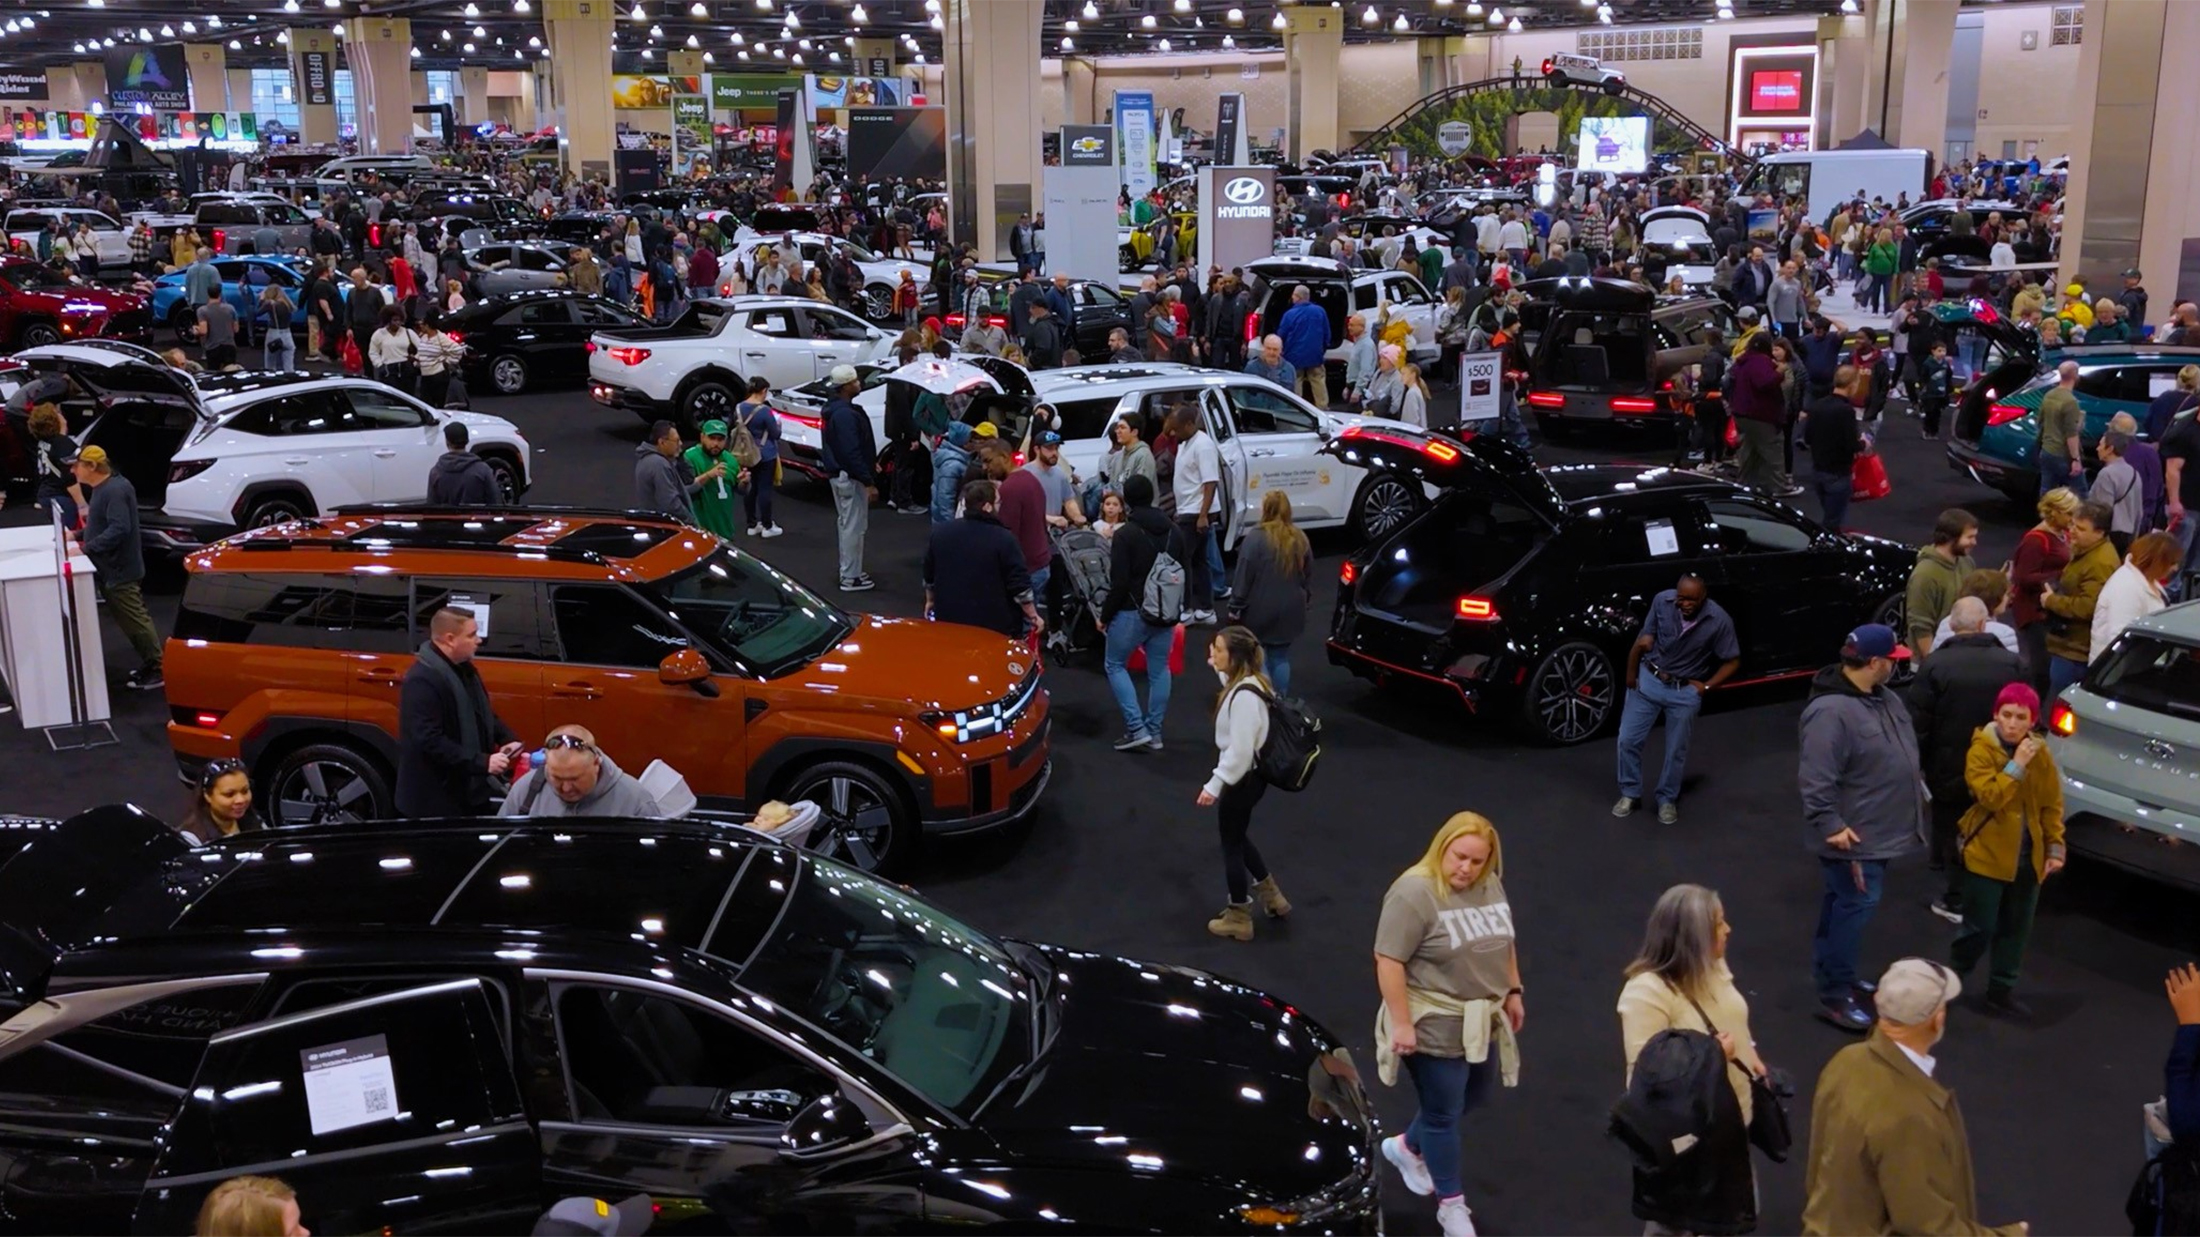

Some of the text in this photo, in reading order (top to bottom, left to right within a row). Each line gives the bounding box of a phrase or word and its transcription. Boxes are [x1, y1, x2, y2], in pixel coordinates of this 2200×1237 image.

[308, 54, 327, 103] OFFROD
[112, 90, 186, 101] CUSTOM ALLEY
[716, 86, 742, 98] Jeep
[679, 103, 705, 114] Jeep
[738, 129, 777, 143] CRD
[1217, 206, 1271, 218] HYUNDAI
[1467, 364, 1494, 377] $500
[2118, 752, 2200, 780] VENUE
